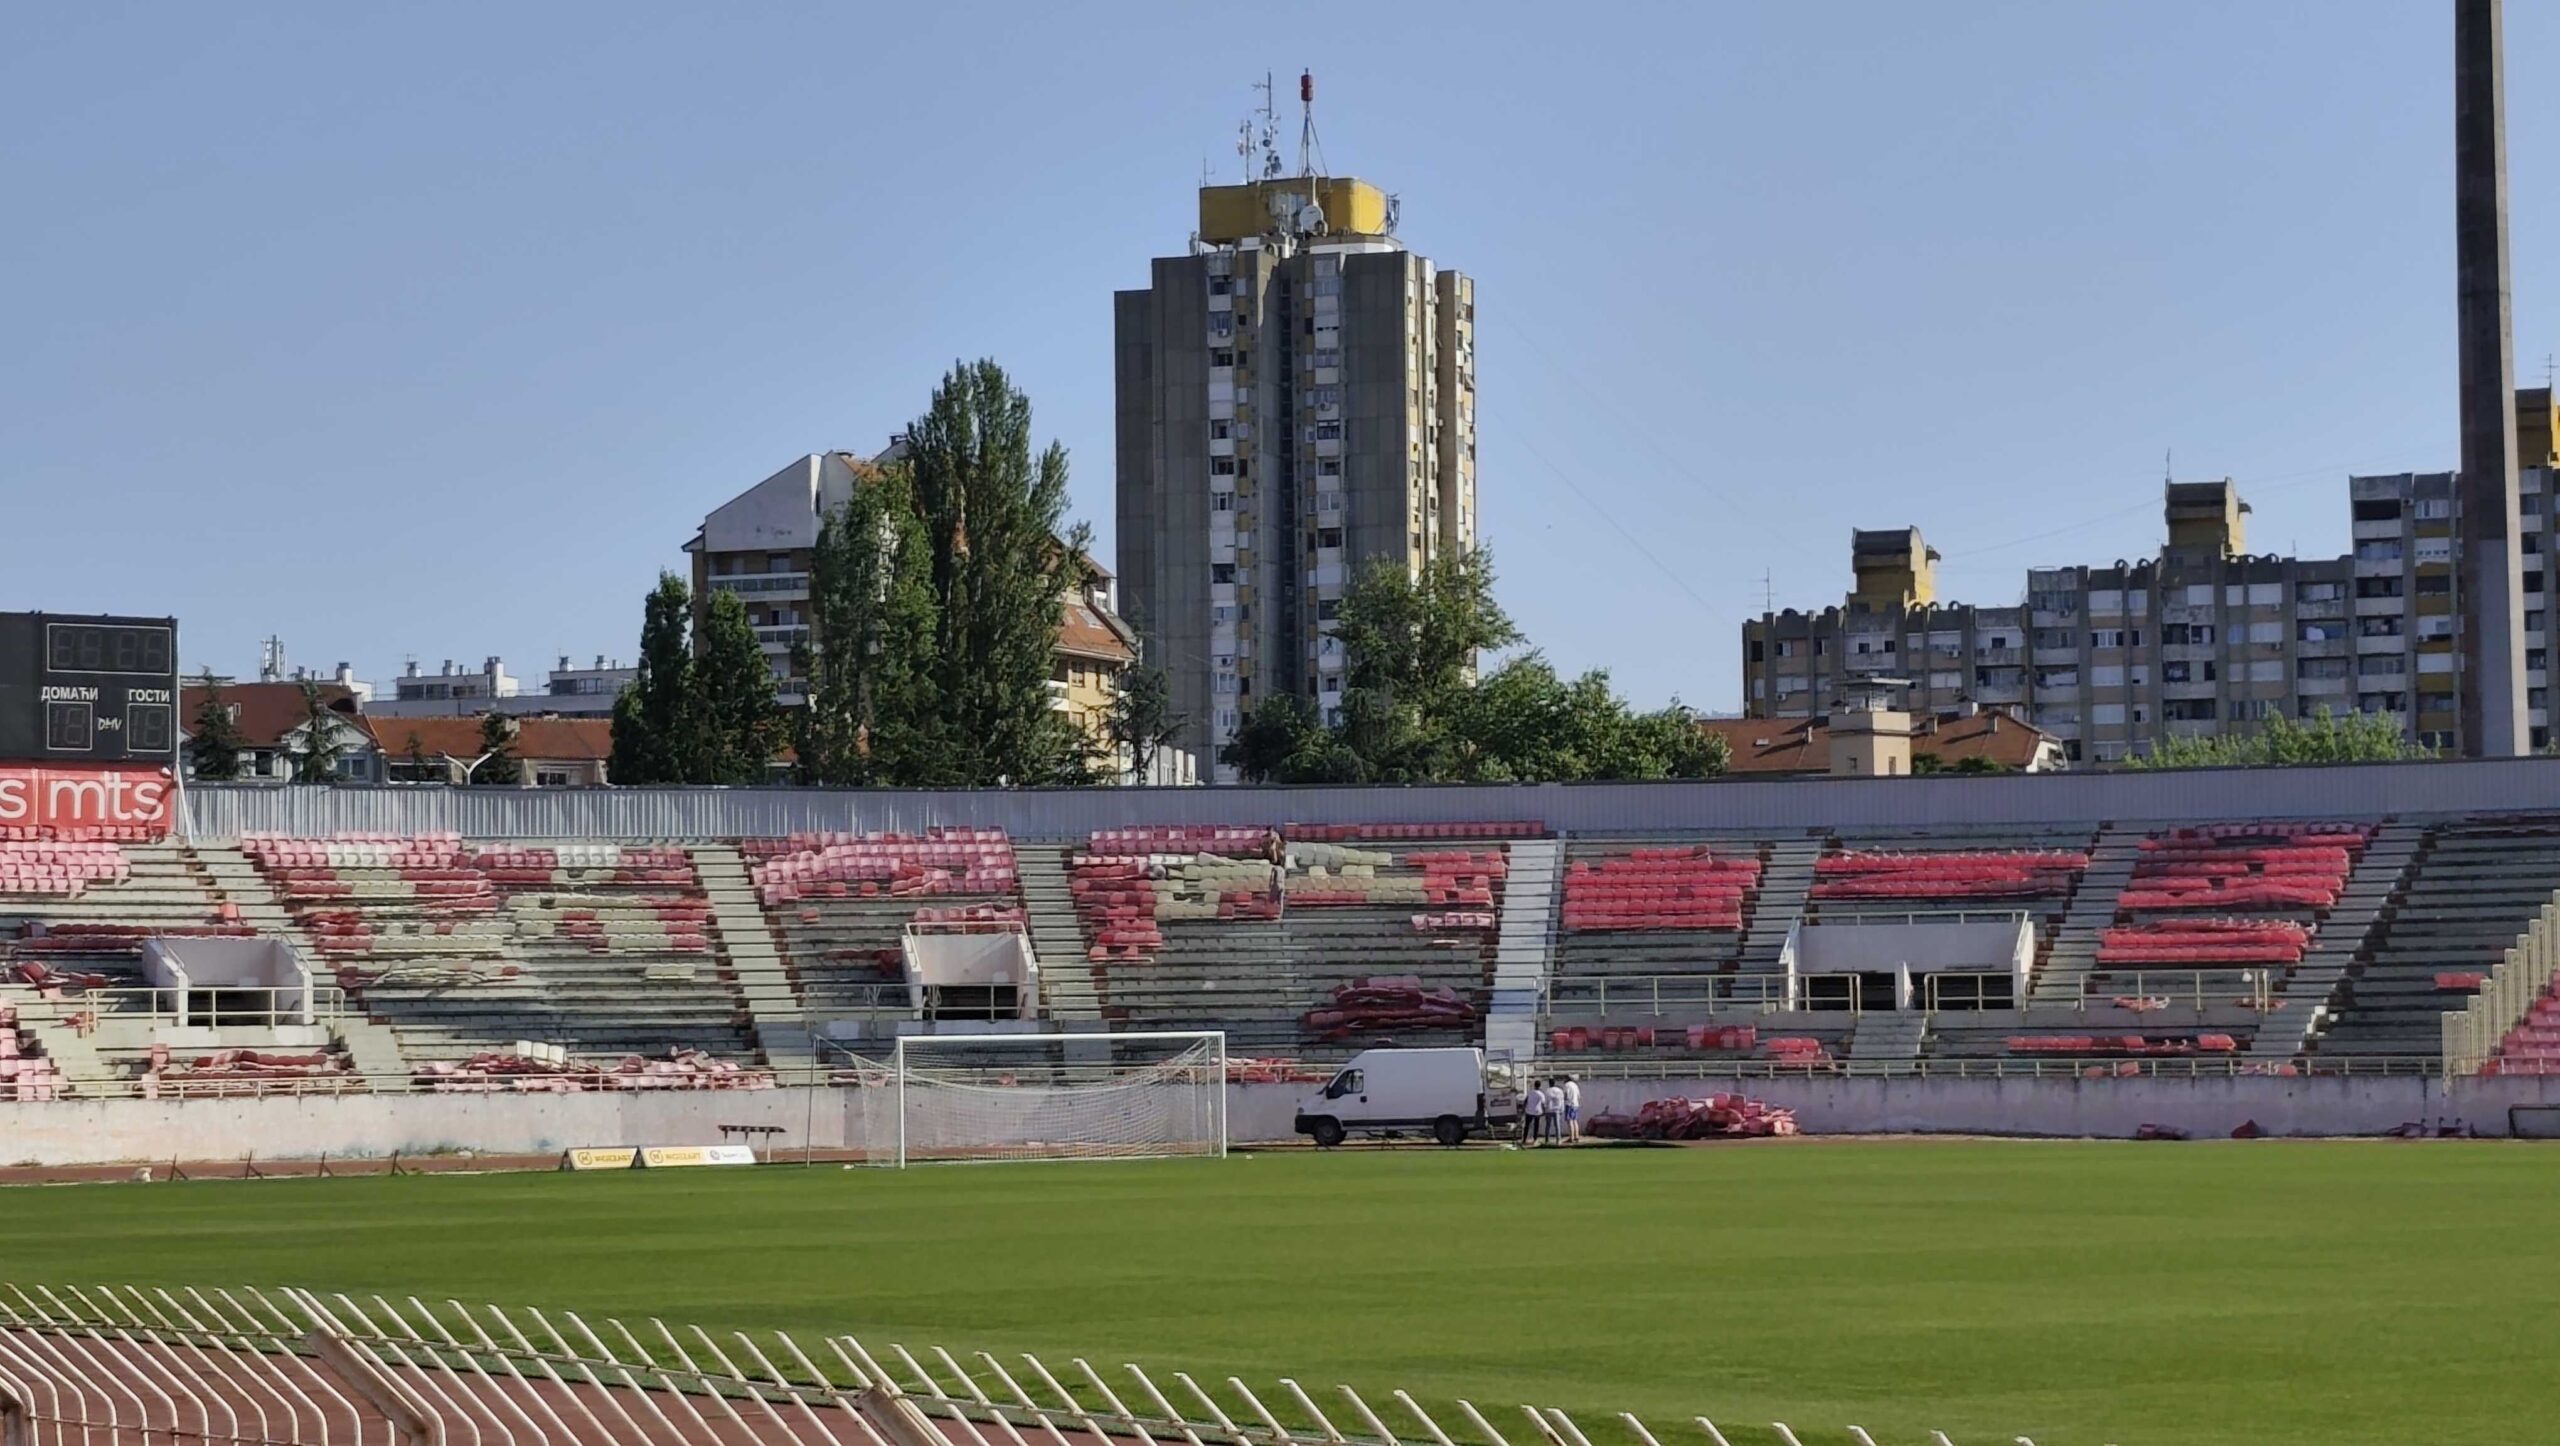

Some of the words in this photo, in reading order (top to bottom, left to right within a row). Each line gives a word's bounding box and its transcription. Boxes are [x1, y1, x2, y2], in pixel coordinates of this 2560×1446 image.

[41, 686, 98, 702] ДОМАЋИ
[128, 689, 169, 702] ГОСТИ
[50, 774, 164, 820] mts
